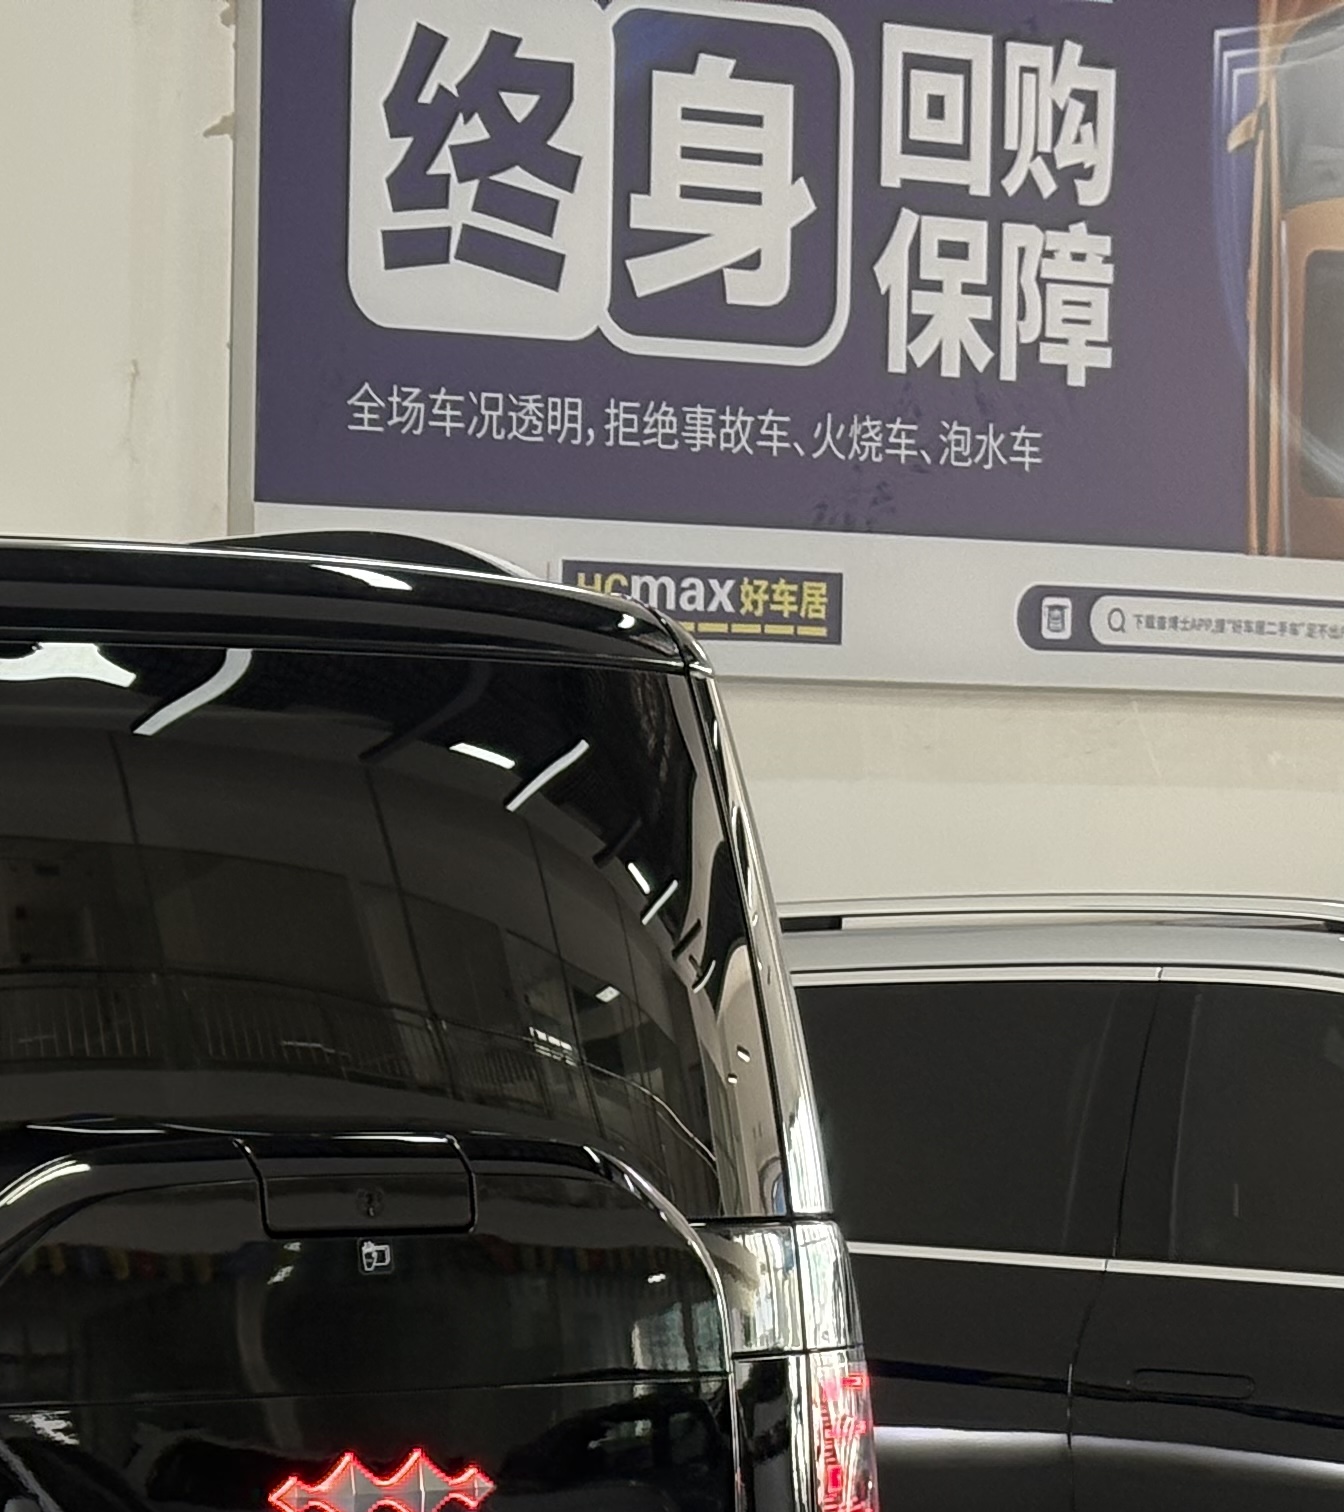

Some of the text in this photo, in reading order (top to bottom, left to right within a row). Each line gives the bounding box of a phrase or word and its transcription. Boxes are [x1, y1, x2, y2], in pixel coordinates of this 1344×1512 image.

[379, 19, 817, 308] 终身
[879, 22, 1118, 209] 回购
[873, 207, 1116, 388] 保障
[739, 576, 829, 620] 好车居
